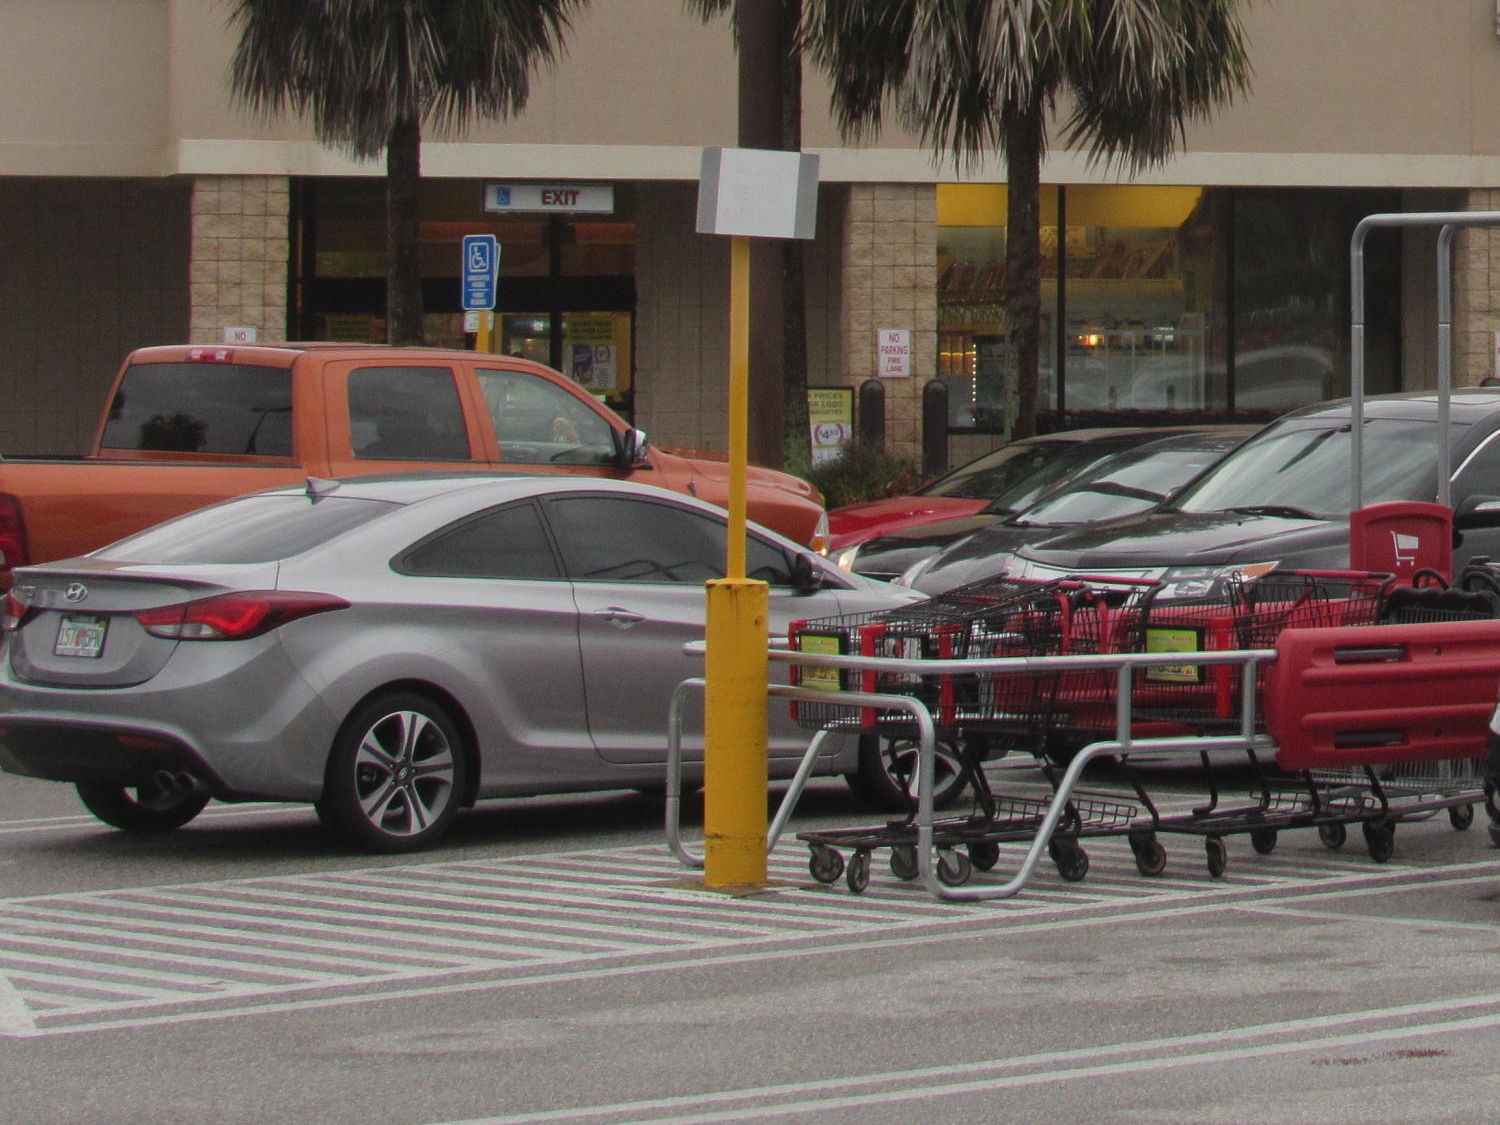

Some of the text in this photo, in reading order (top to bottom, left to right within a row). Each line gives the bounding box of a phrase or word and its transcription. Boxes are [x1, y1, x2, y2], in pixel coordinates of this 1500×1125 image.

[541, 189, 580, 206] EXIT
[234, 330, 247, 341] NO
[888, 333, 900, 343] NO
[880, 345, 909, 355] PARKING
[887, 356, 901, 364] FIRE
